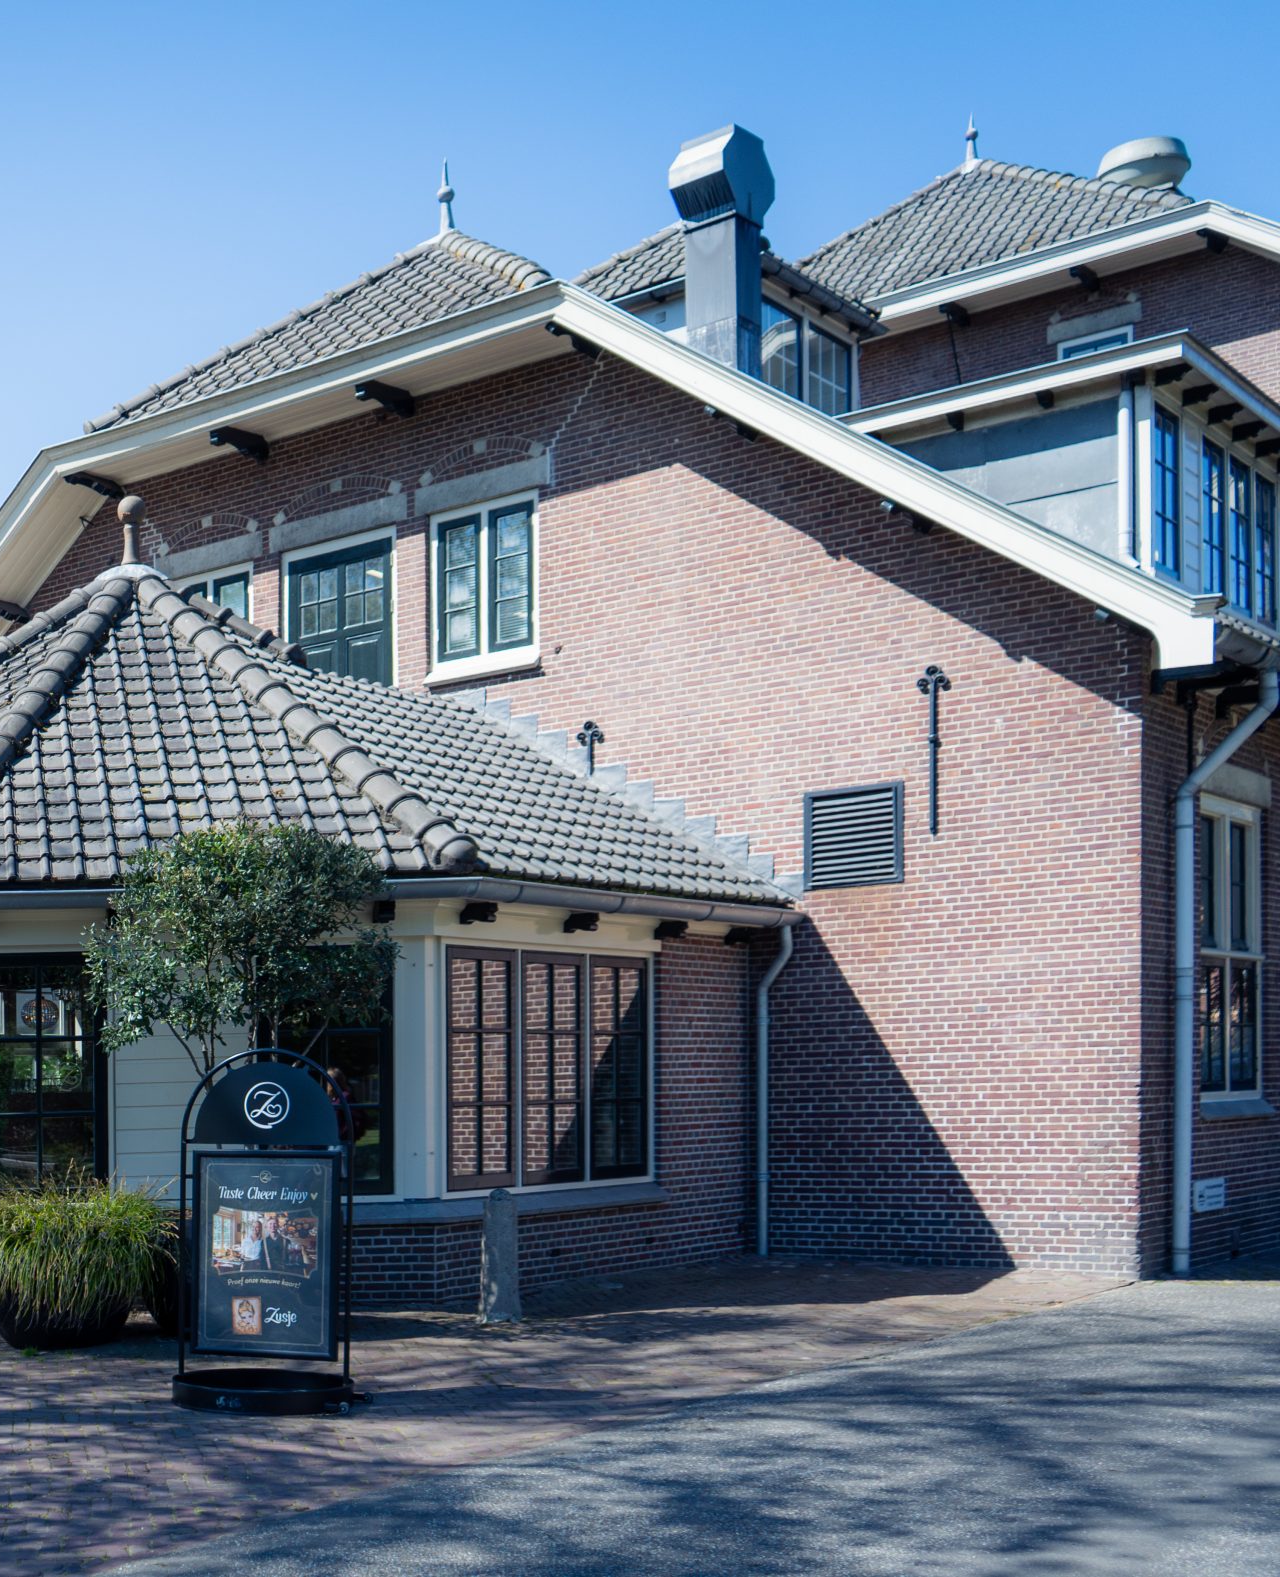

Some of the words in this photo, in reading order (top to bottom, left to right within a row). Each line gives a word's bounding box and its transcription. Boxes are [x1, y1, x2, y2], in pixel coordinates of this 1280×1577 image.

[218, 1185, 245, 1200] Taste
[247, 1186, 277, 1200] Cheer
[280, 1186, 308, 1204] Enjoy
[227, 1276, 244, 1287] Proef
[244, 1277, 258, 1285] onze
[259, 1276, 281, 1285] nieuwe
[263, 1306, 297, 1328] Zusje
